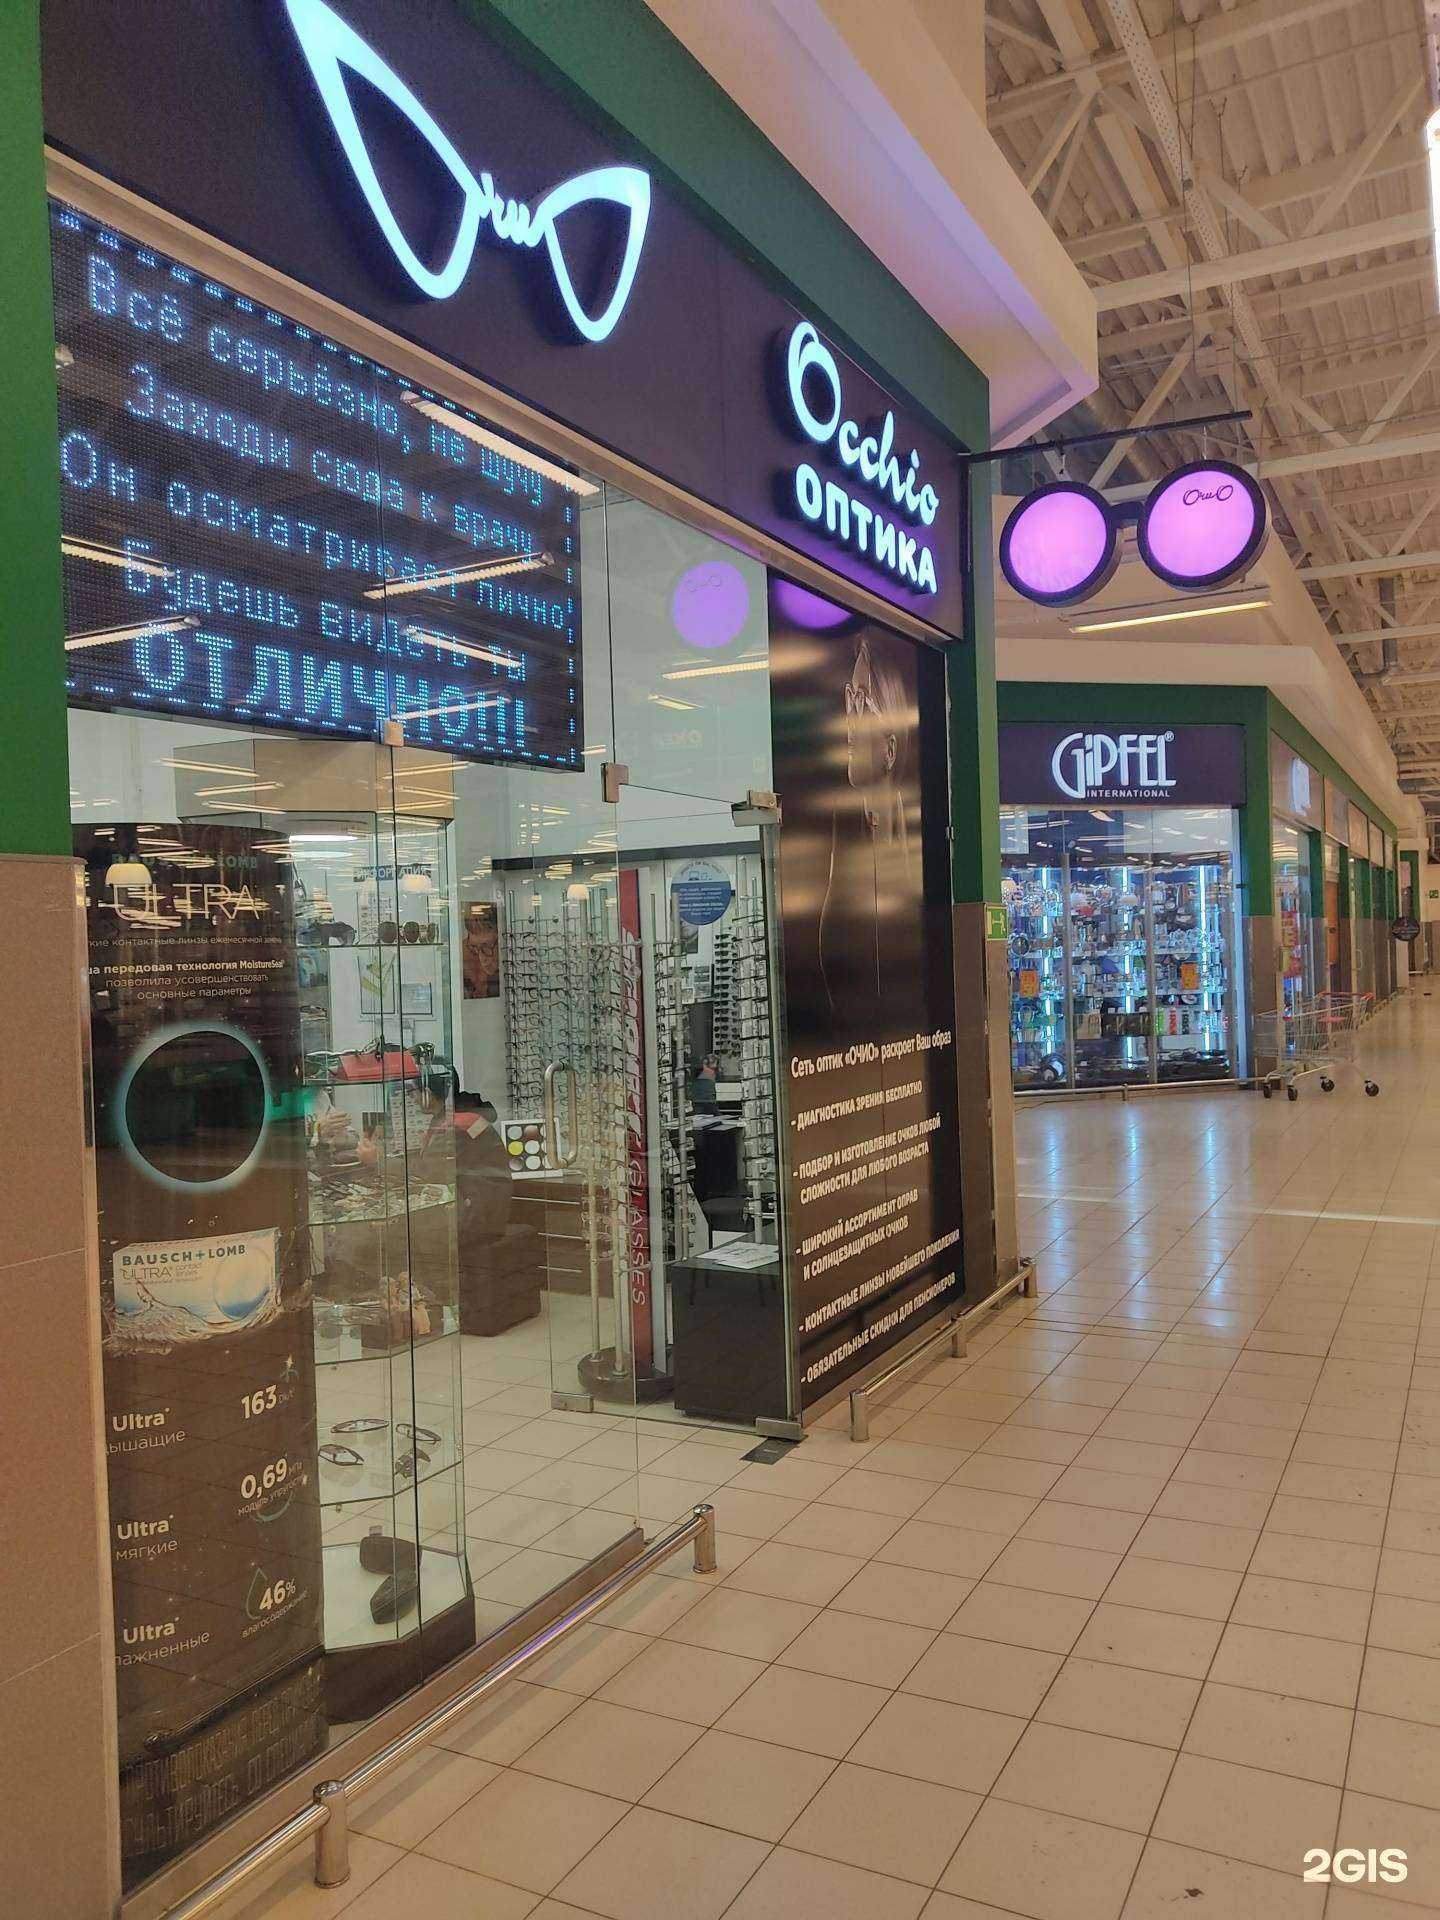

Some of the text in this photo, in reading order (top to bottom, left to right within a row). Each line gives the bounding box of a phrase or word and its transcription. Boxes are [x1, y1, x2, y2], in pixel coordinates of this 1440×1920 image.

[88, 254, 183, 343] Всё
[431, 425, 465, 464] не
[481, 448, 543, 506] шучу
[787, 321, 939, 525] Occhio
[127, 364, 532, 564] Заходи сюда к врачу
[60, 431, 135, 502] Он
[169, 482, 457, 597] осматривает
[795, 463, 938, 594] ОПТИКА
[125, 538, 526, 682] Будешь видеть ты
[1086, 789, 1171, 798] INTERNATIONAL
[113, 883, 260, 920] ULTRA
[112, 936, 176, 946] контактные
[177, 936, 208, 945] линзы
[104, 962, 173, 977] передовая
[177, 961, 238, 972] технология
[105, 975, 269, 988] позволила усовершенствовать
[137, 987, 252, 1000] основные параметры
[791, 1029, 952, 1078] Сеть оптик «ОЧИО» раскроет Ваш образ
[797, 1098, 856, 1131] ДИАГНОСТИКА
[856, 1091, 885, 1111] ЗРЕНИЯ
[885, 1080, 923, 1103] БЕСПЛАТНО
[799, 1154, 833, 1180] ПОДБОР
[834, 1150, 841, 1167] И
[841, 1131, 897, 1164] ИЗГОТОВЛЕНИЕ
[897, 1123, 919, 1144] ОЧКОВ
[919, 1112, 941, 1136] ЛЮБОЙ
[800, 1141, 930, 1205] СЛОЖНОСТИ ДЛЯ ЛЮБОГО ВОЗРАСТА
[802, 1218, 844, 1256] ШИРОКИЙ
[844, 1198, 897, 1235] АССОРТИМЕНТ
[897, 1188, 919, 1210] ОПРАВ
[803, 1215, 909, 1281] И СОЛНЦЕЗАЩИТНЫХ ОЧКОВ
[805, 1287, 859, 1332] КОНТАКТНЫЕ
[859, 1272, 885, 1300] ЛИНЗЫ
[885, 1249, 926, 1284] НОВЕЙШЕГО
[926, 1229, 960, 1259] ПОКОЛЕНИЯ
[806, 1331, 870, 1383] ОБЯЗАТЕЛЬНЫЕ
[869, 1310, 899, 1340] СКИДКИ
[899, 1303, 914, 1323] ДЛЯ
[913, 1272, 956, 1311] ПЕНСИОНЕРОВ
[240, 1384, 278, 1419] 163
[105, 1430, 186, 1455] ышащие
[240, 1457, 288, 1499] 0,69
[115, 1540, 179, 1561] мягкие
[259, 1578, 297, 1611] 46%
